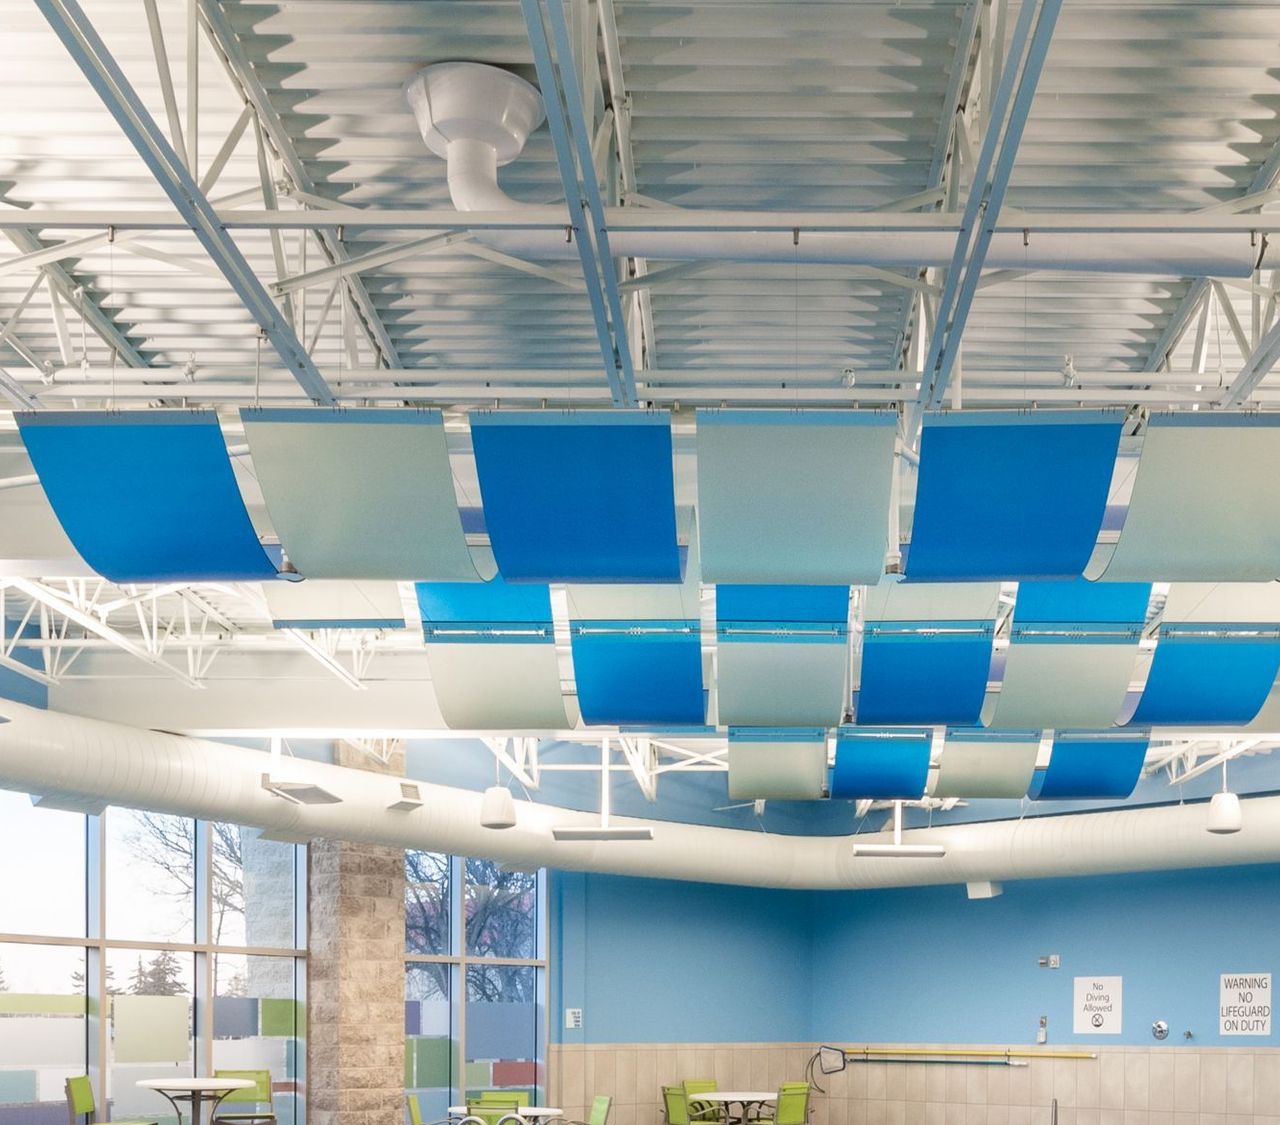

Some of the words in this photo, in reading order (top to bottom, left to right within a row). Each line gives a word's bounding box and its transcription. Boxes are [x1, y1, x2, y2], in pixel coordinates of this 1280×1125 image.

[1092, 982, 1104, 991] No
[1224, 977, 1268, 989] WARNING
[1086, 993, 1110, 1003] Diving
[1238, 991, 1253, 1003] NO
[1083, 1002, 1112, 1012] Allowed
[1221, 1006, 1271, 1018] LIFEGUARD
[1224, 1020, 1239, 1032] ON
[1241, 1019, 1267, 1032] DUTY
